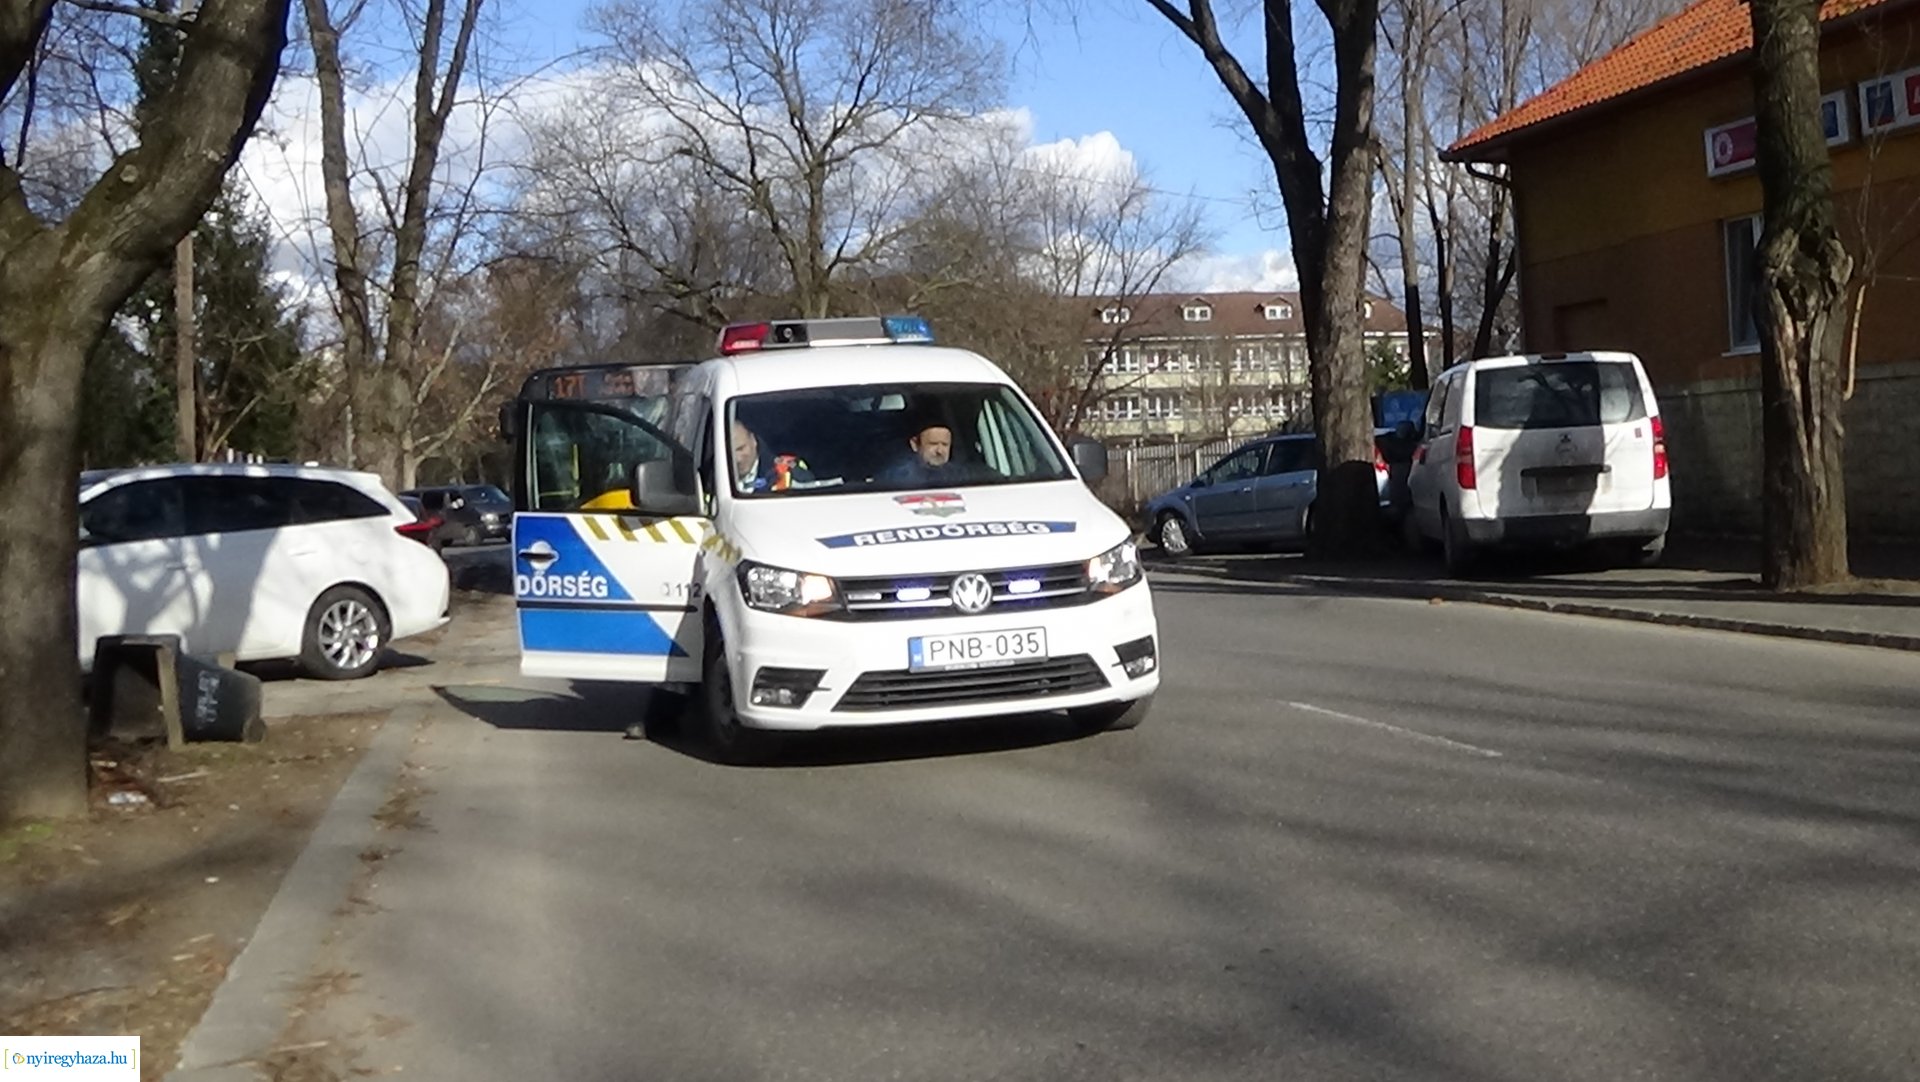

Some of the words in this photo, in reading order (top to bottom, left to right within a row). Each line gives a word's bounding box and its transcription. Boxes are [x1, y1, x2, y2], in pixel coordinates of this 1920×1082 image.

[853, 520, 1051, 547] RENDŐRSÉG
[517, 571, 609, 597] DŐRSÉG
[675, 583, 702, 598] 112
[930, 632, 1040, 661] PNB-035
